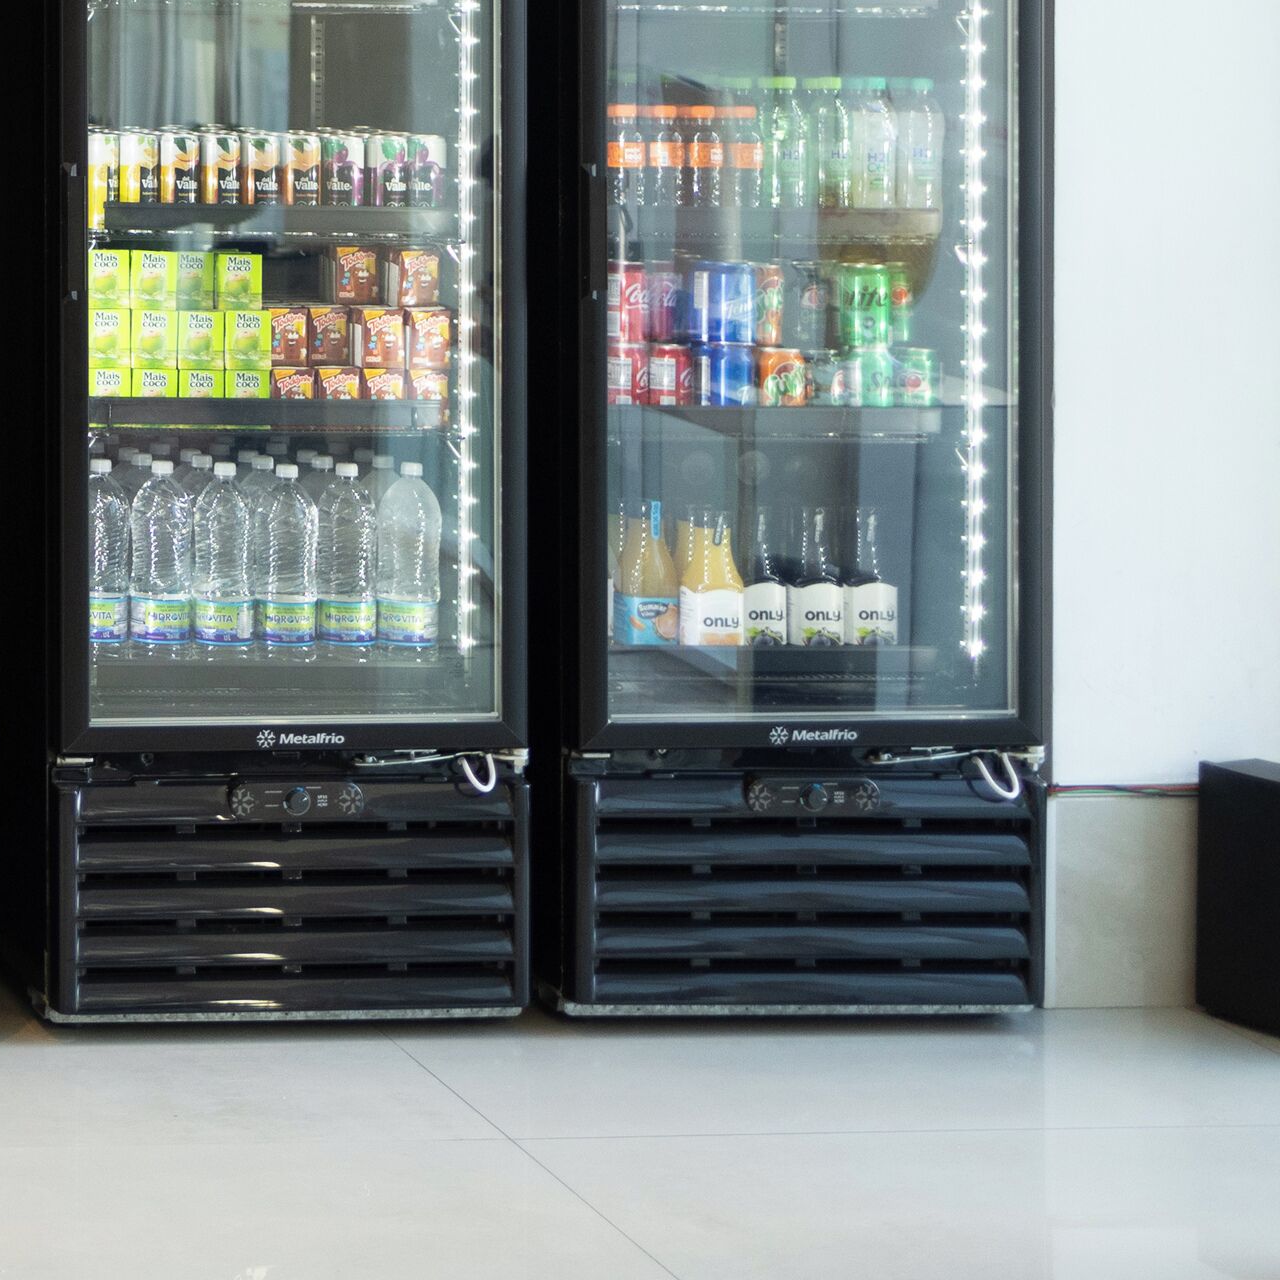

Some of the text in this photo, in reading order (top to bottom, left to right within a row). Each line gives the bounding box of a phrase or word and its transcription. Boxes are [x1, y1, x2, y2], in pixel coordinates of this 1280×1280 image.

[94, 252, 119, 263] Mais
[227, 256, 251, 266] Mais
[94, 311, 119, 322] Mais
[236, 313, 261, 323] Mais
[94, 321, 119, 329] coco
[235, 322, 261, 330] coco
[279, 732, 345, 746] Metalfrio
[792, 728, 858, 742] Metalfrio
